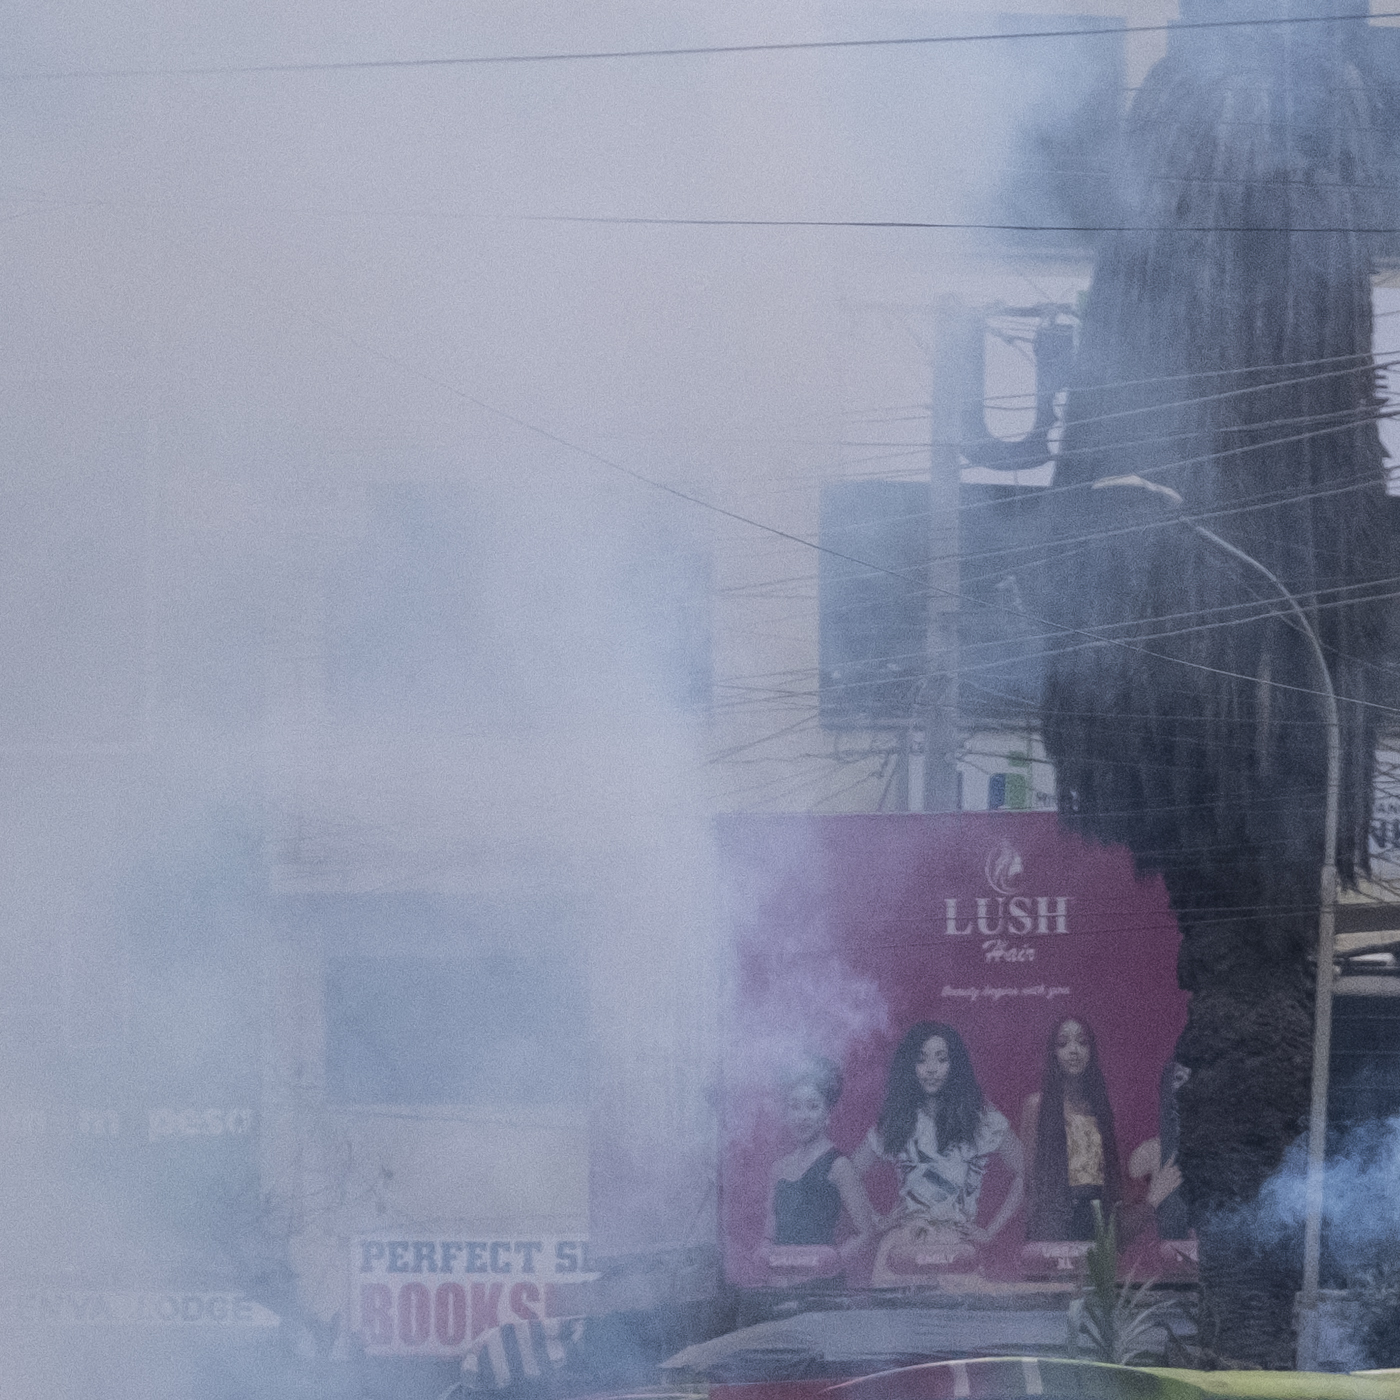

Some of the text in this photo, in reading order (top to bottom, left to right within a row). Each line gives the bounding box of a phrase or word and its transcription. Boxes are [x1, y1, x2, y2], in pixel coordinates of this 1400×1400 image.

[943, 896, 1071, 936] LUSH
[981, 938, 1037, 963] Hair
[359, 1239, 542, 1274] PERFECT
[137, 1294, 255, 1321] LODGE
[359, 1280, 557, 1347] BOOKS
